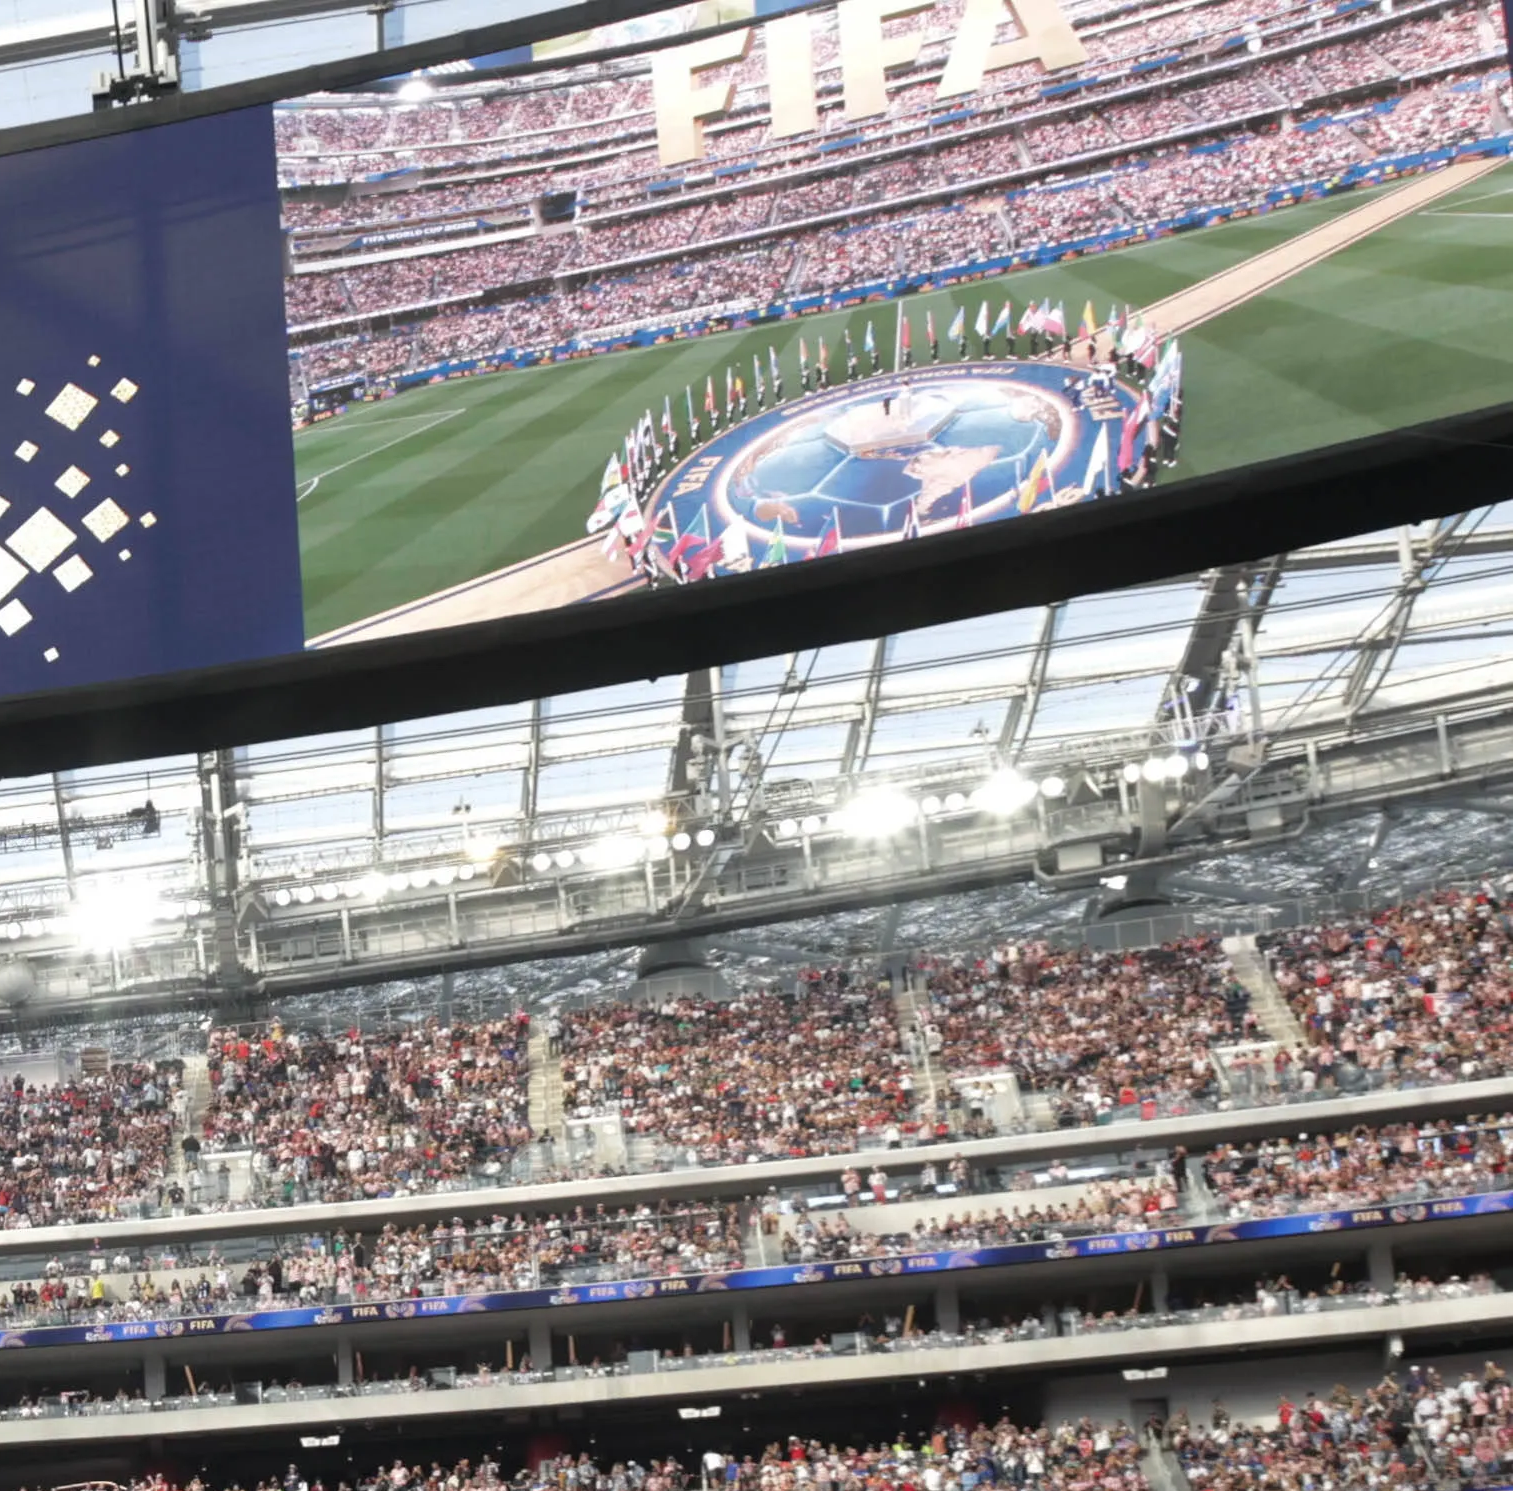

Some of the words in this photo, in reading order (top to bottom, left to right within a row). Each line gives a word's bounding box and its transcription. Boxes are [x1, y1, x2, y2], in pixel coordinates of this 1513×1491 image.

[653, 0, 1090, 167] FIFA
[1433, 1201, 1465, 1214] FIFA
[1352, 1210, 1383, 1222] FIFA
[1165, 1230, 1194, 1242] FIFA
[1089, 1238, 1119, 1250] FIFA
[908, 1256, 937, 1268] FIFA
[834, 1264, 863, 1275] FIFA
[661, 1280, 688, 1291] FIFA
[590, 1286, 617, 1297] FIFA
[422, 1300, 449, 1311] FIFA
[352, 1306, 378, 1317] FIFA
[123, 1325, 148, 1335] FIFA
[190, 1320, 215, 1330] FIFA
